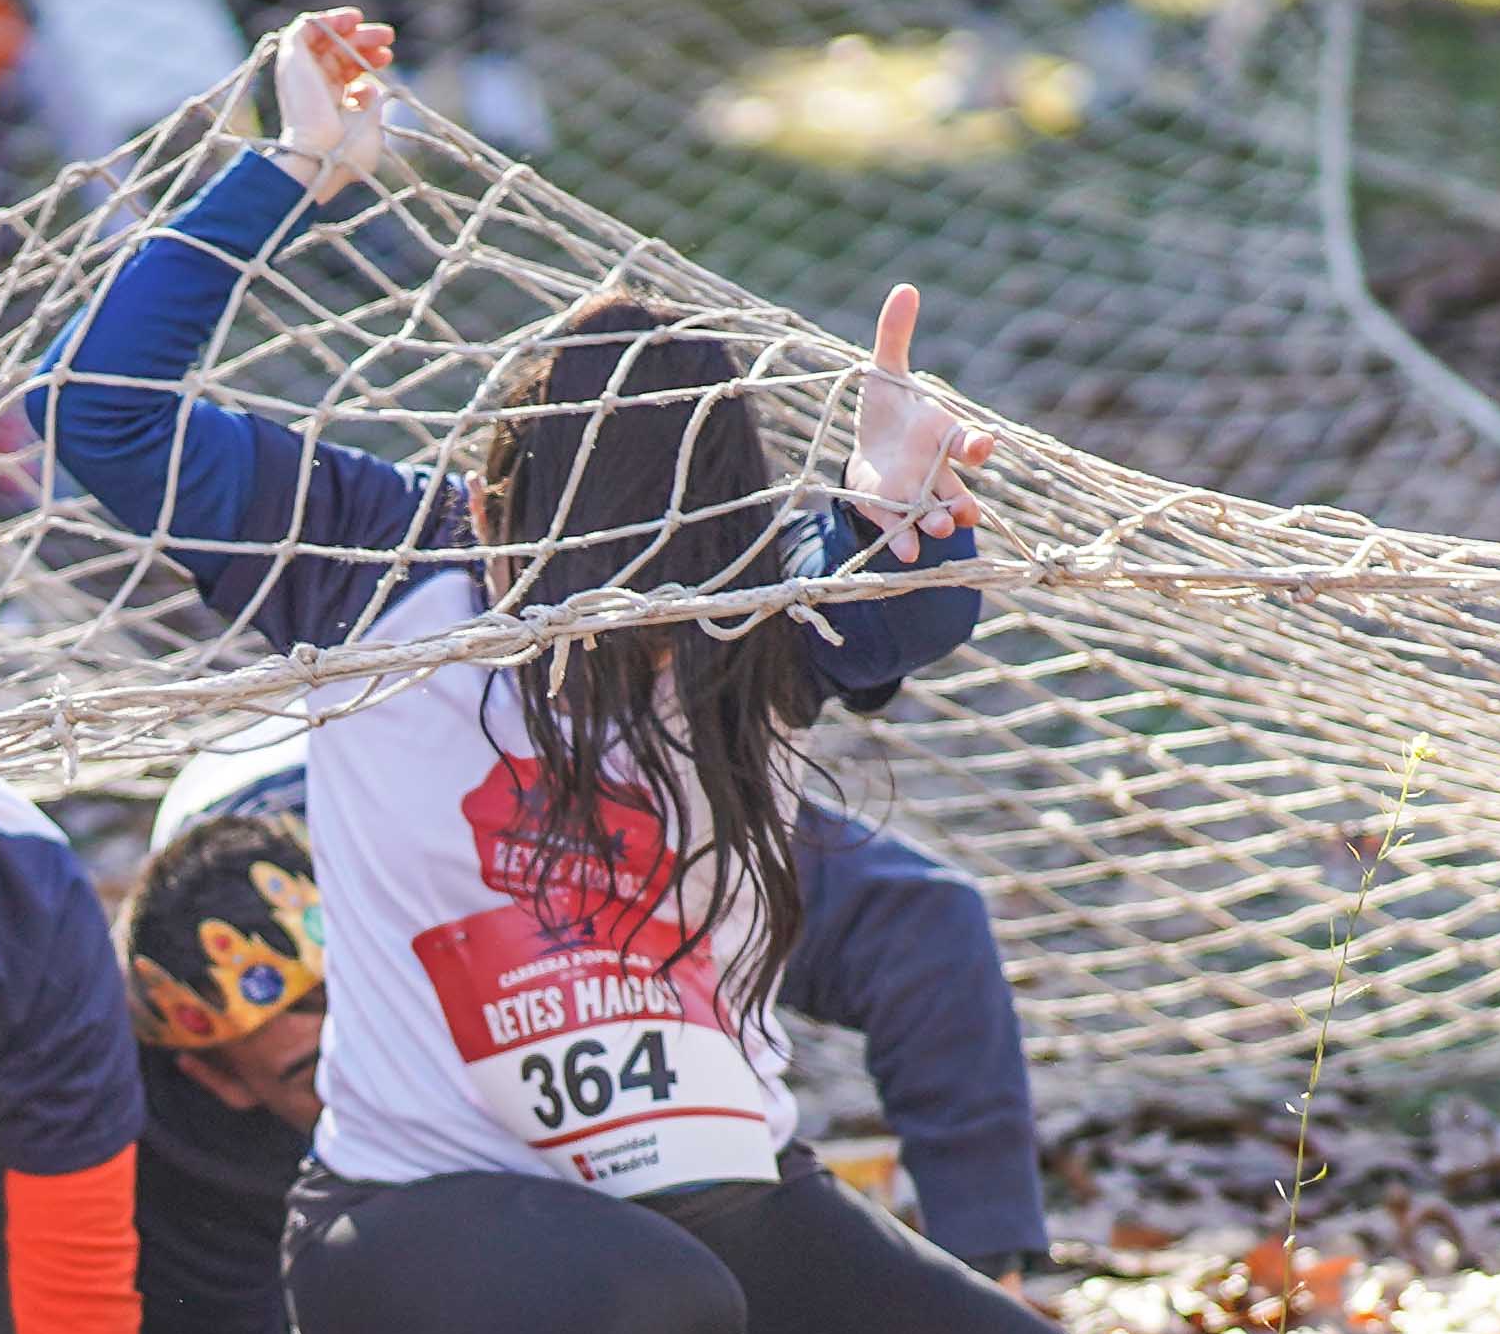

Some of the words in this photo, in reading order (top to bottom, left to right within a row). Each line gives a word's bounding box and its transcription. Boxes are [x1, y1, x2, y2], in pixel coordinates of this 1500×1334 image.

[483, 984, 566, 1046] REYES
[573, 974, 683, 1024] MAGOS
[521, 1029, 679, 1130] 364
